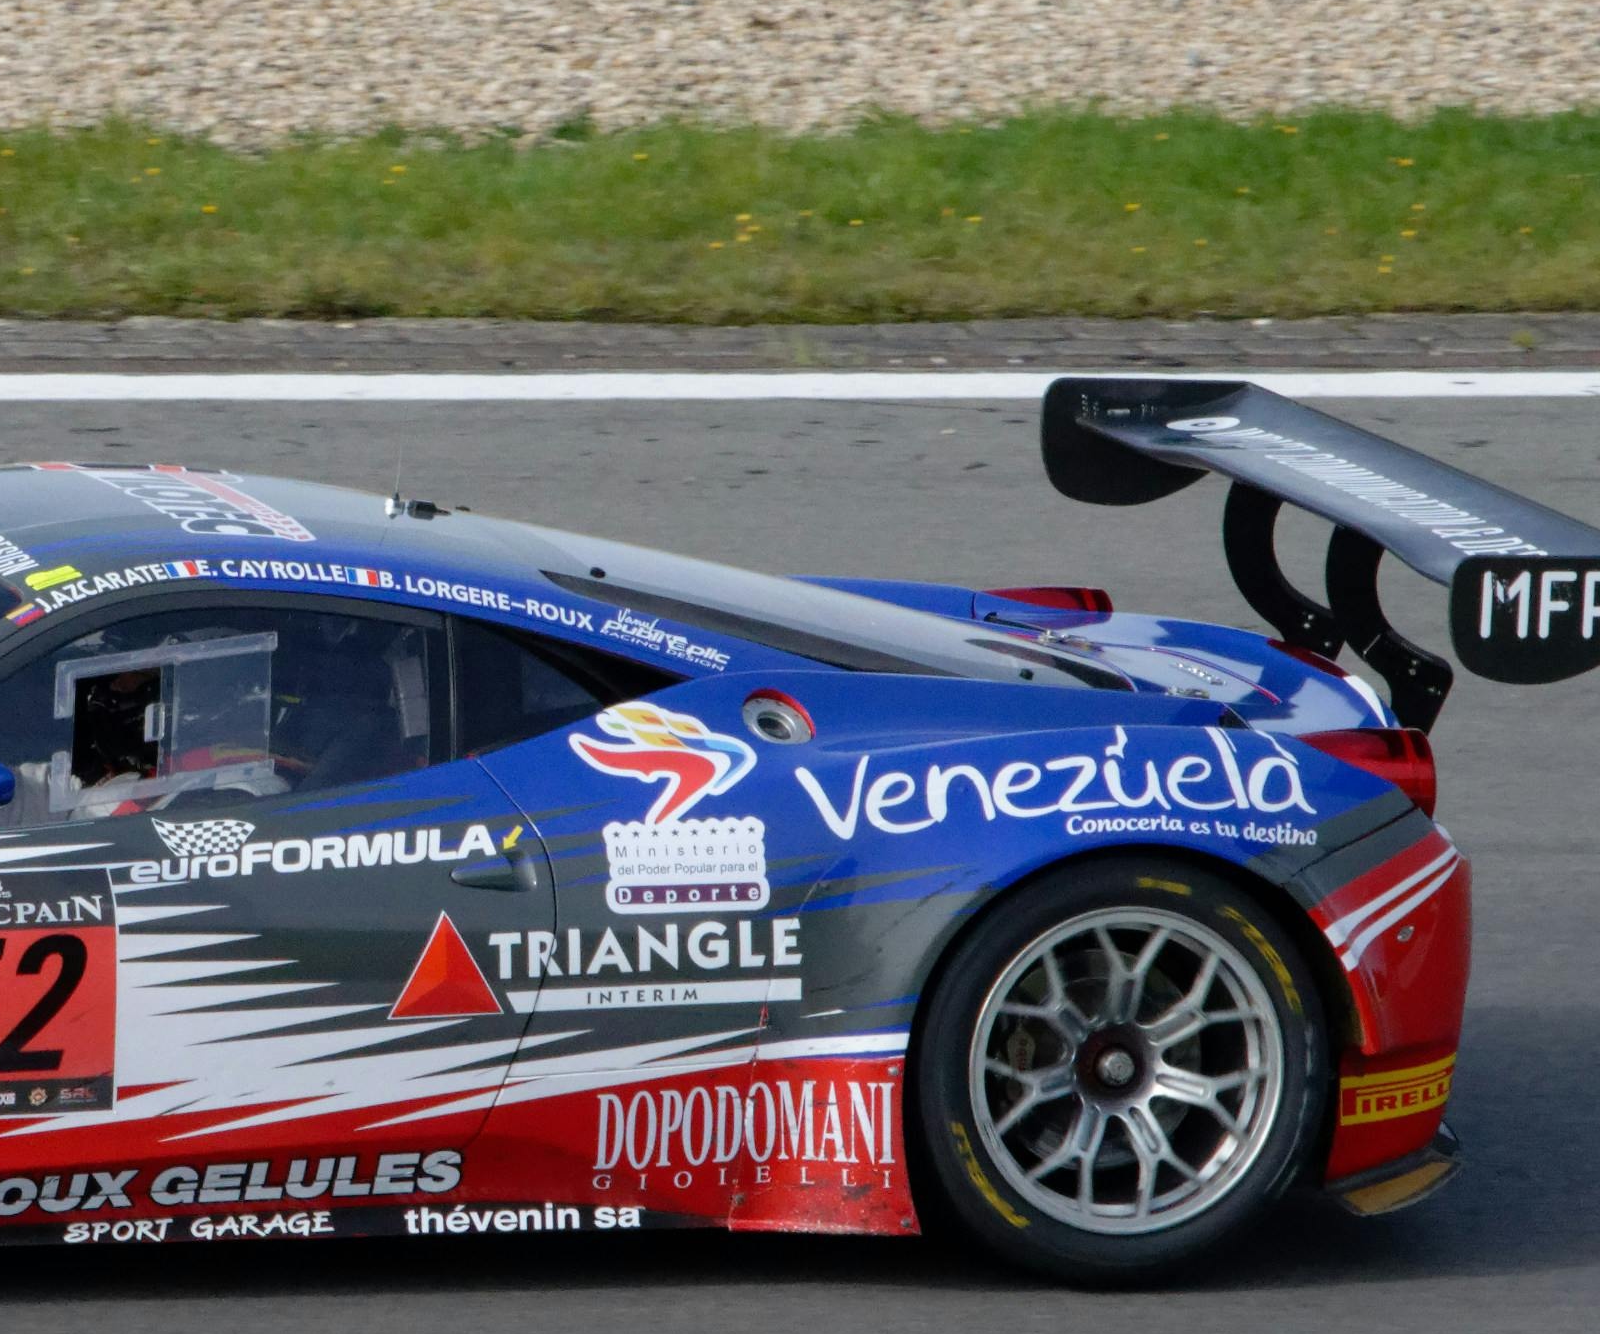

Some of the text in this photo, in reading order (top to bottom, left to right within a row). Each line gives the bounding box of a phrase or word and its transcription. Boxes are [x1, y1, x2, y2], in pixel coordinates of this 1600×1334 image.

[198, 560, 218, 577] E.
[221, 560, 348, 582] CAYROLLE
[379, 571, 401, 590] B.
[1066, 814, 1317, 846] Conocerla es tu destino
[129, 825, 497, 884] euroFORMULA
[615, 844, 757, 858] Ministerio
[618, 861, 759, 876] del Poder Popular para el
[617, 884, 760, 905] Deporte
[488, 918, 803, 979] TRIANGLE
[587, 988, 699, 1005] INTERIM
[593, 1080, 895, 1170] DOPODOMANI
[150, 1149, 465, 1208] GELULES
[593, 1166, 892, 1190] GIOIELLI
[63, 1210, 335, 1244] SPORT GARAGE
[404, 1201, 643, 1236] thévenin sa
